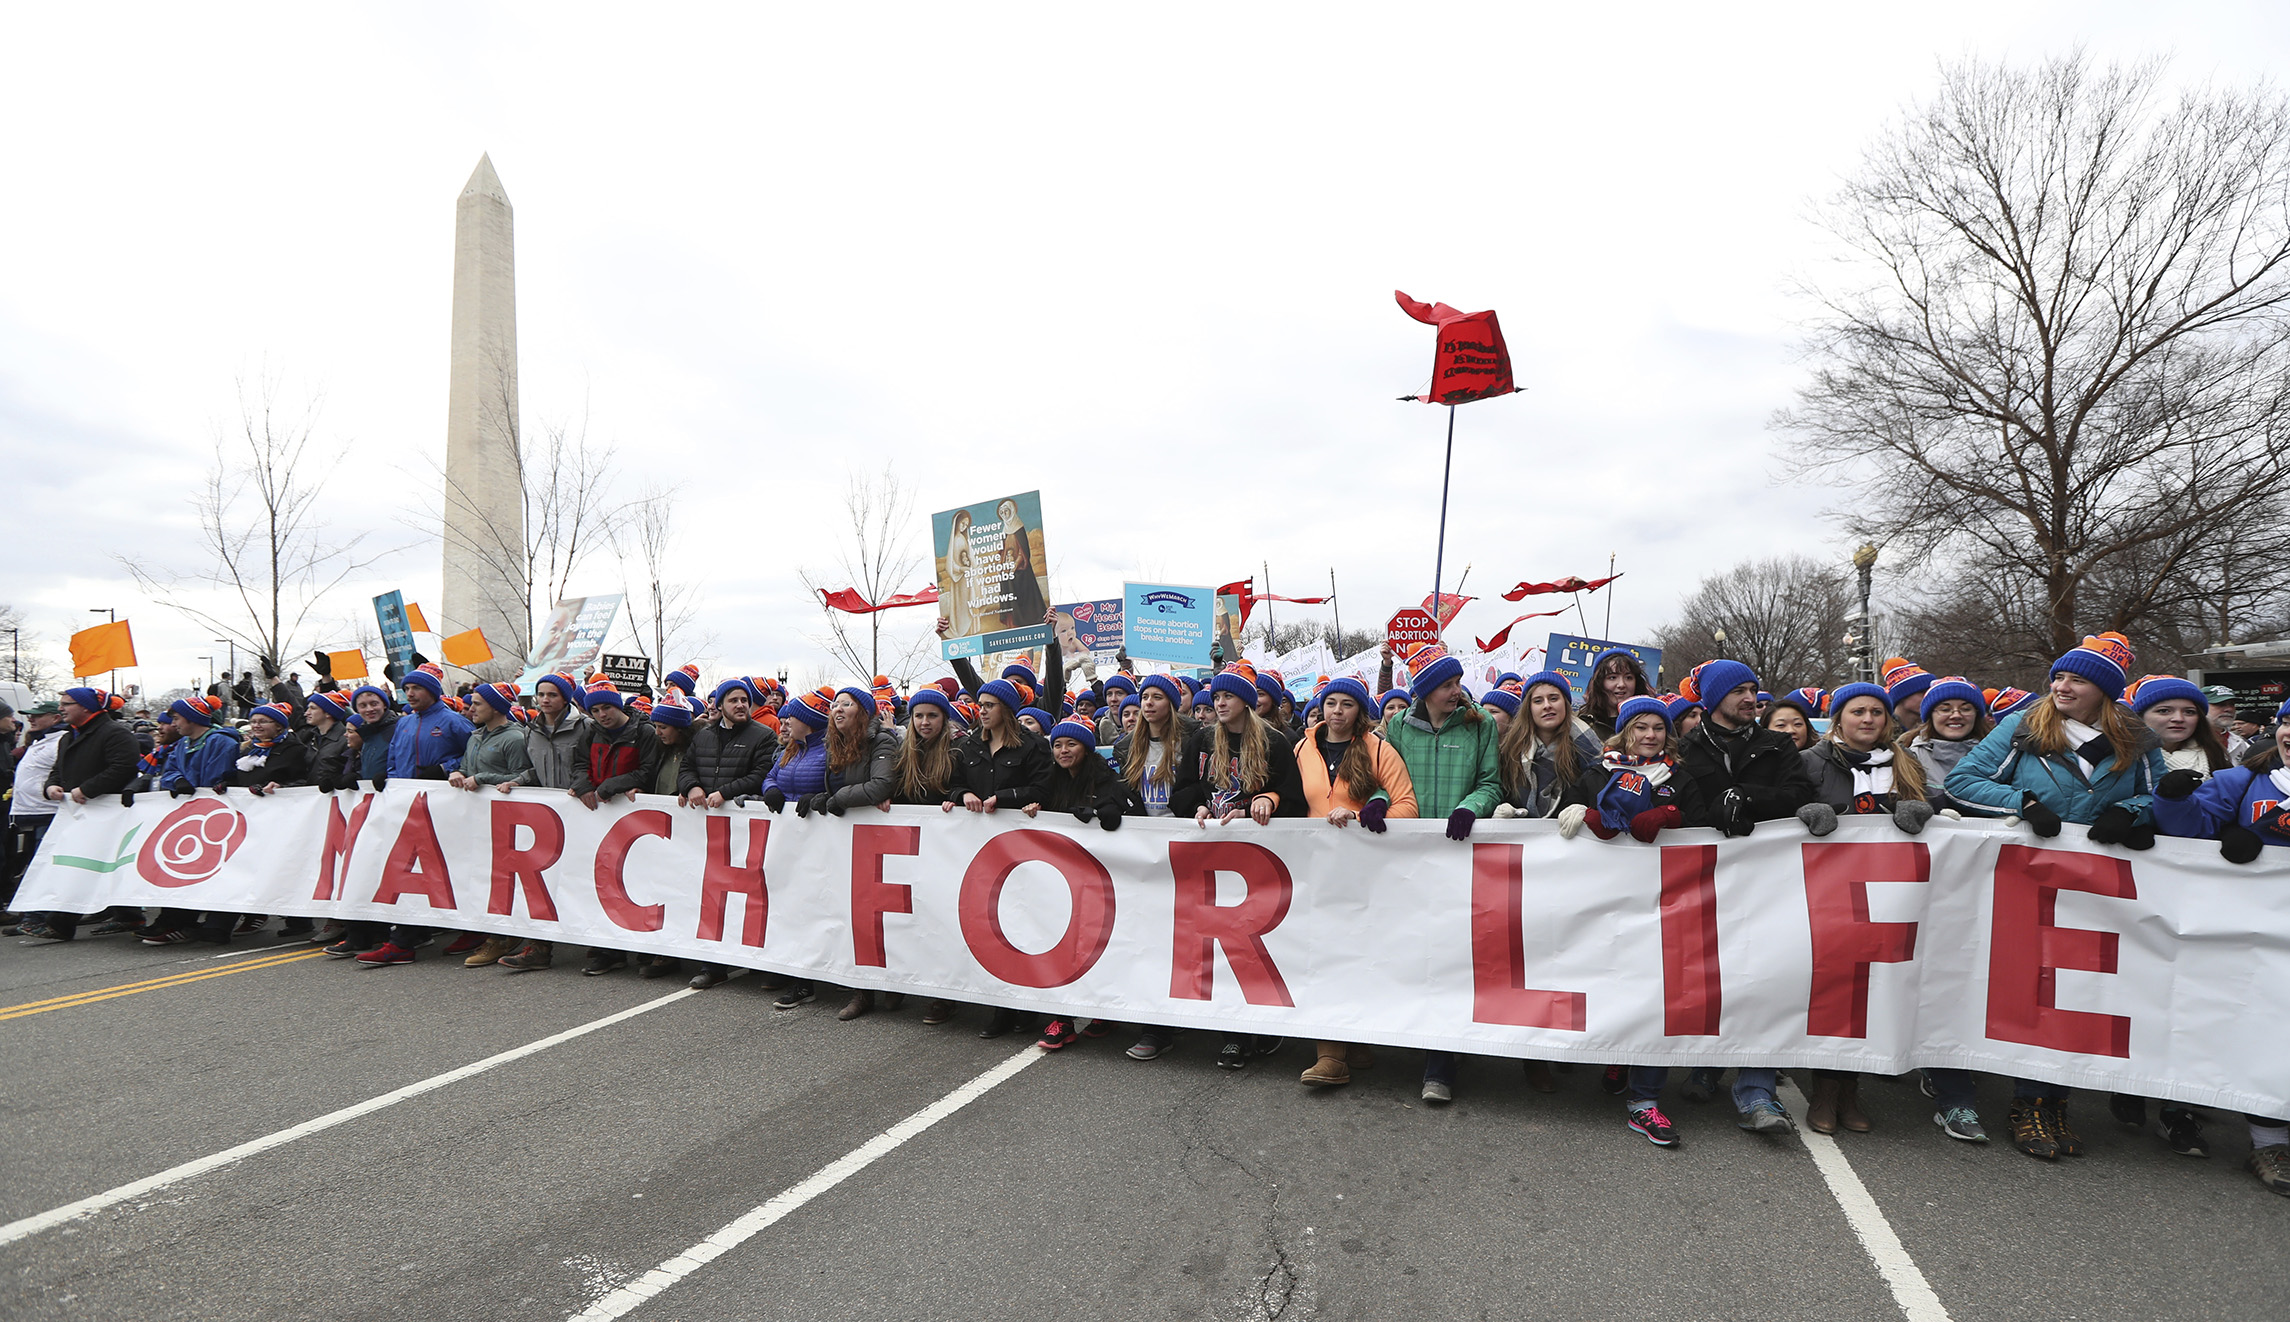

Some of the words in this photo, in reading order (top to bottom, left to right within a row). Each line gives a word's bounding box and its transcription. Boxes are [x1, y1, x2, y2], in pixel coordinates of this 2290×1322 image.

[970, 521, 1002, 536] Fewer
[968, 532, 1006, 546] women
[972, 541, 1004, 555] would
[976, 553, 1001, 566] have
[964, 561, 1016, 578] abortions
[966, 578, 975, 588] if
[976, 570, 1015, 585] wombs
[981, 583, 1001, 595] had
[967, 591, 1018, 608] windows.
[585, 601, 616, 612] Babies
[1100, 602, 1117, 613] My
[576, 612, 593, 621] can
[594, 611, 612, 620] feel
[1093, 611, 1123, 623] Heart
[1396, 617, 1429, 628] STOP
[565, 622, 582, 633] joy
[583, 620, 608, 630] while
[1137, 616, 1167, 627] Because
[1167, 619, 1199, 630] abortion
[576, 630, 585, 638] in
[586, 630, 603, 638] the
[1133, 625, 1153, 636] stops
[1154, 628, 1167, 636] one
[1168, 628, 1185, 637] heart
[1186, 629, 1203, 638] and
[1388, 630, 1438, 640] ABORTION
[566, 639, 598, 649] womb.
[989, 633, 1046, 647] SAVETHESTORKS.COM
[1140, 633, 1163, 643] breaks
[1164, 636, 1195, 645] another.
[2101, 648, 2124, 662] FOR
[605, 656, 614, 667] I
[615, 657, 646, 670] AM
[604, 671, 644, 681] PRO-LIFE
[1555, 667, 1579, 678] Born
[313, 791, 770, 949] MARCH
[851, 825, 1294, 1008] FOR
[1472, 843, 2136, 1058] LIFE
